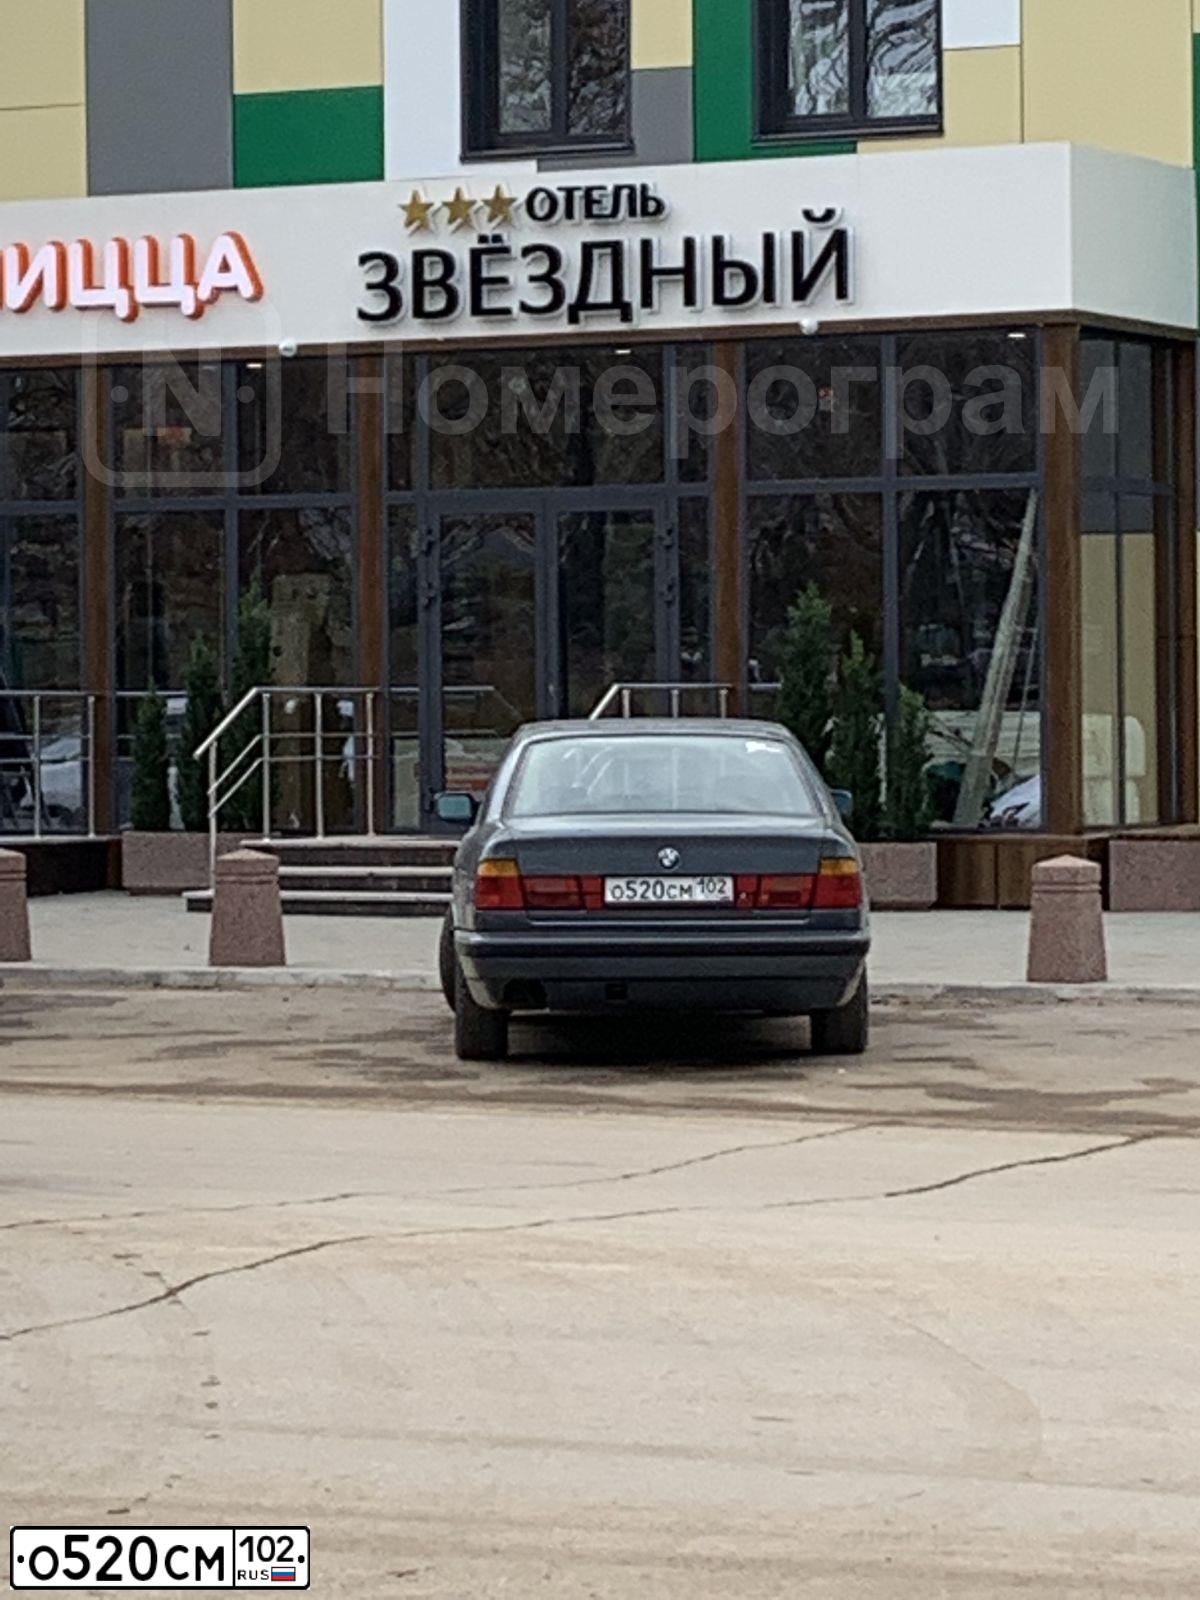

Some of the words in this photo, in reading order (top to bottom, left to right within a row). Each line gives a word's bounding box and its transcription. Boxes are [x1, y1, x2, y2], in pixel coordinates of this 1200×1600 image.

[526, 182, 667, 223] ОТЕЛЬ
[0, 231, 264, 323] ИЦЦА
[356, 207, 850, 326] ЗВЁЗДНЫЙ
[697, 876, 727, 894] 102
